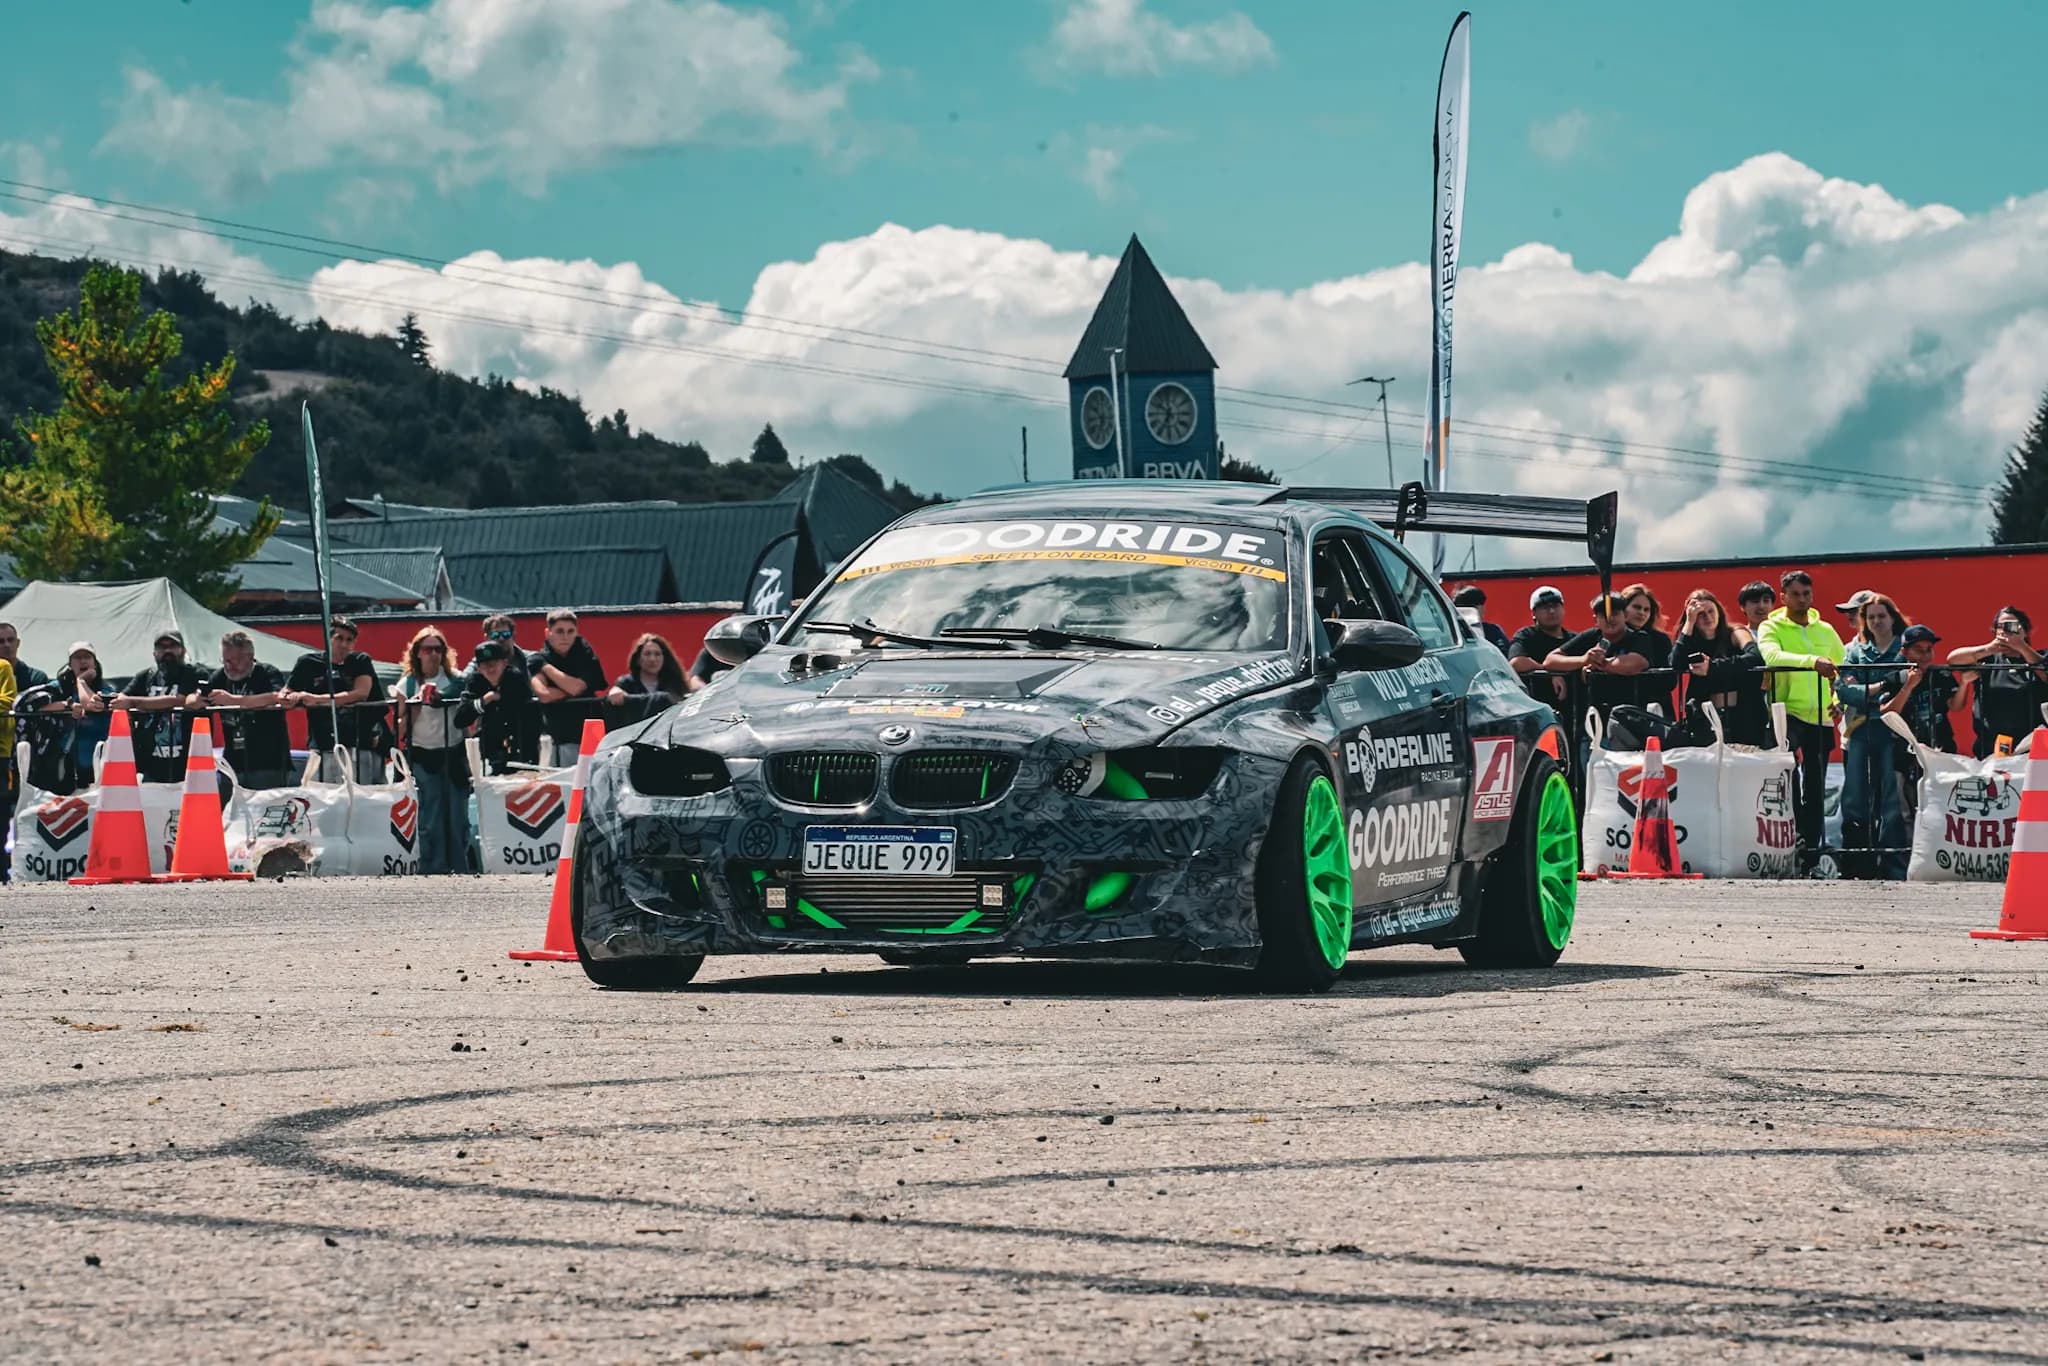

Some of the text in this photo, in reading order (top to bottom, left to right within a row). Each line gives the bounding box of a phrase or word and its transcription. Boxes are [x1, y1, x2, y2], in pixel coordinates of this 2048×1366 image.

[1143, 459, 1207, 479] BBVA
[926, 522, 1266, 562] OODRIDE
[970, 551, 1147, 562] SAFETY ON BOARD
[1368, 669, 1408, 701] WILD
[951, 699, 1041, 713] GYM
[1475, 793, 1512, 809] ASTUS
[1348, 798, 1451, 871] GOODRIDE
[503, 841, 561, 866] SÓLID
[807, 844, 949, 871] JEQUE 999
